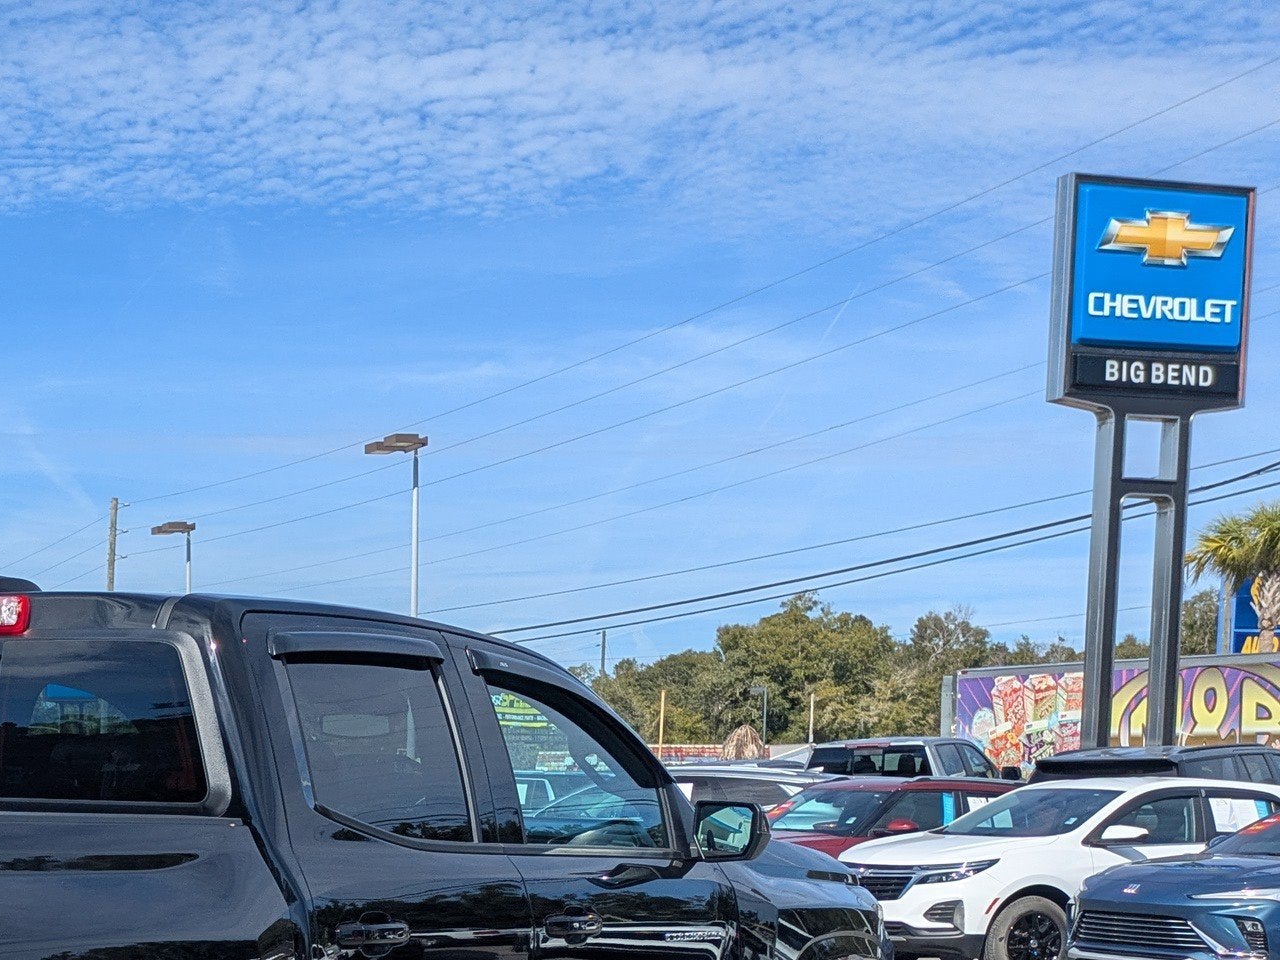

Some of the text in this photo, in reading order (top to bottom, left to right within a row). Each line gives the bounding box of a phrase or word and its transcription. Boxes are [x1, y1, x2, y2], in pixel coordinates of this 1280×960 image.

[1088, 292, 1237, 323] CHEVROLET
[1105, 360, 1213, 387] BIG BEND
